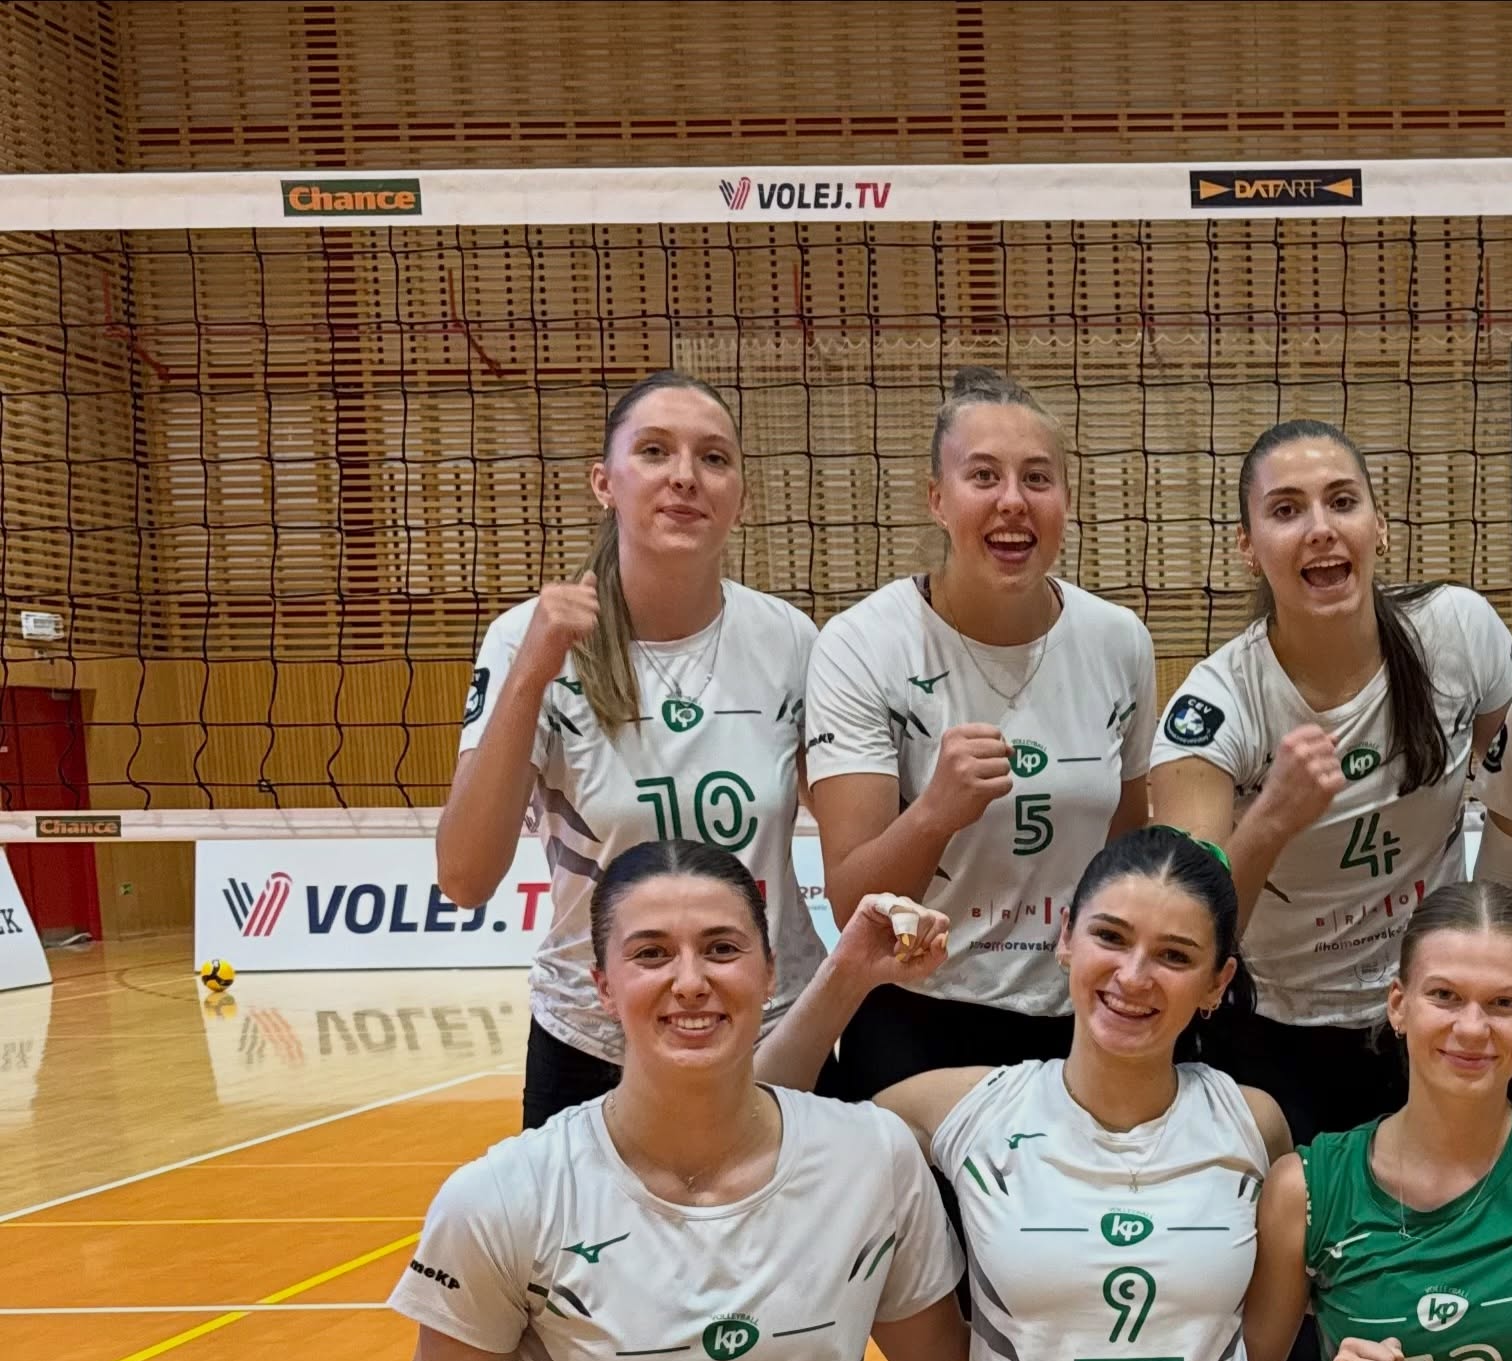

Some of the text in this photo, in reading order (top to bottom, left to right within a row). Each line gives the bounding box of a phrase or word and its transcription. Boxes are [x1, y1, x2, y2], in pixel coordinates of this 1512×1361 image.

[288, 185, 415, 213] Chance
[757, 182, 890, 210] VOLEJ.TV
[1235, 179, 1322, 199] DATART
[635, 770, 758, 851] 10
[1012, 793, 1054, 856] 5
[39, 819, 118, 835] Chance
[1339, 812, 1401, 877] 4
[306, 882, 550, 934] VOLEJ.T
[1111, 1215, 1145, 1241] kp
[1102, 1265, 1157, 1343] 9
[1427, 1297, 1459, 1325] kp
[714, 1325, 749, 1354] kp
